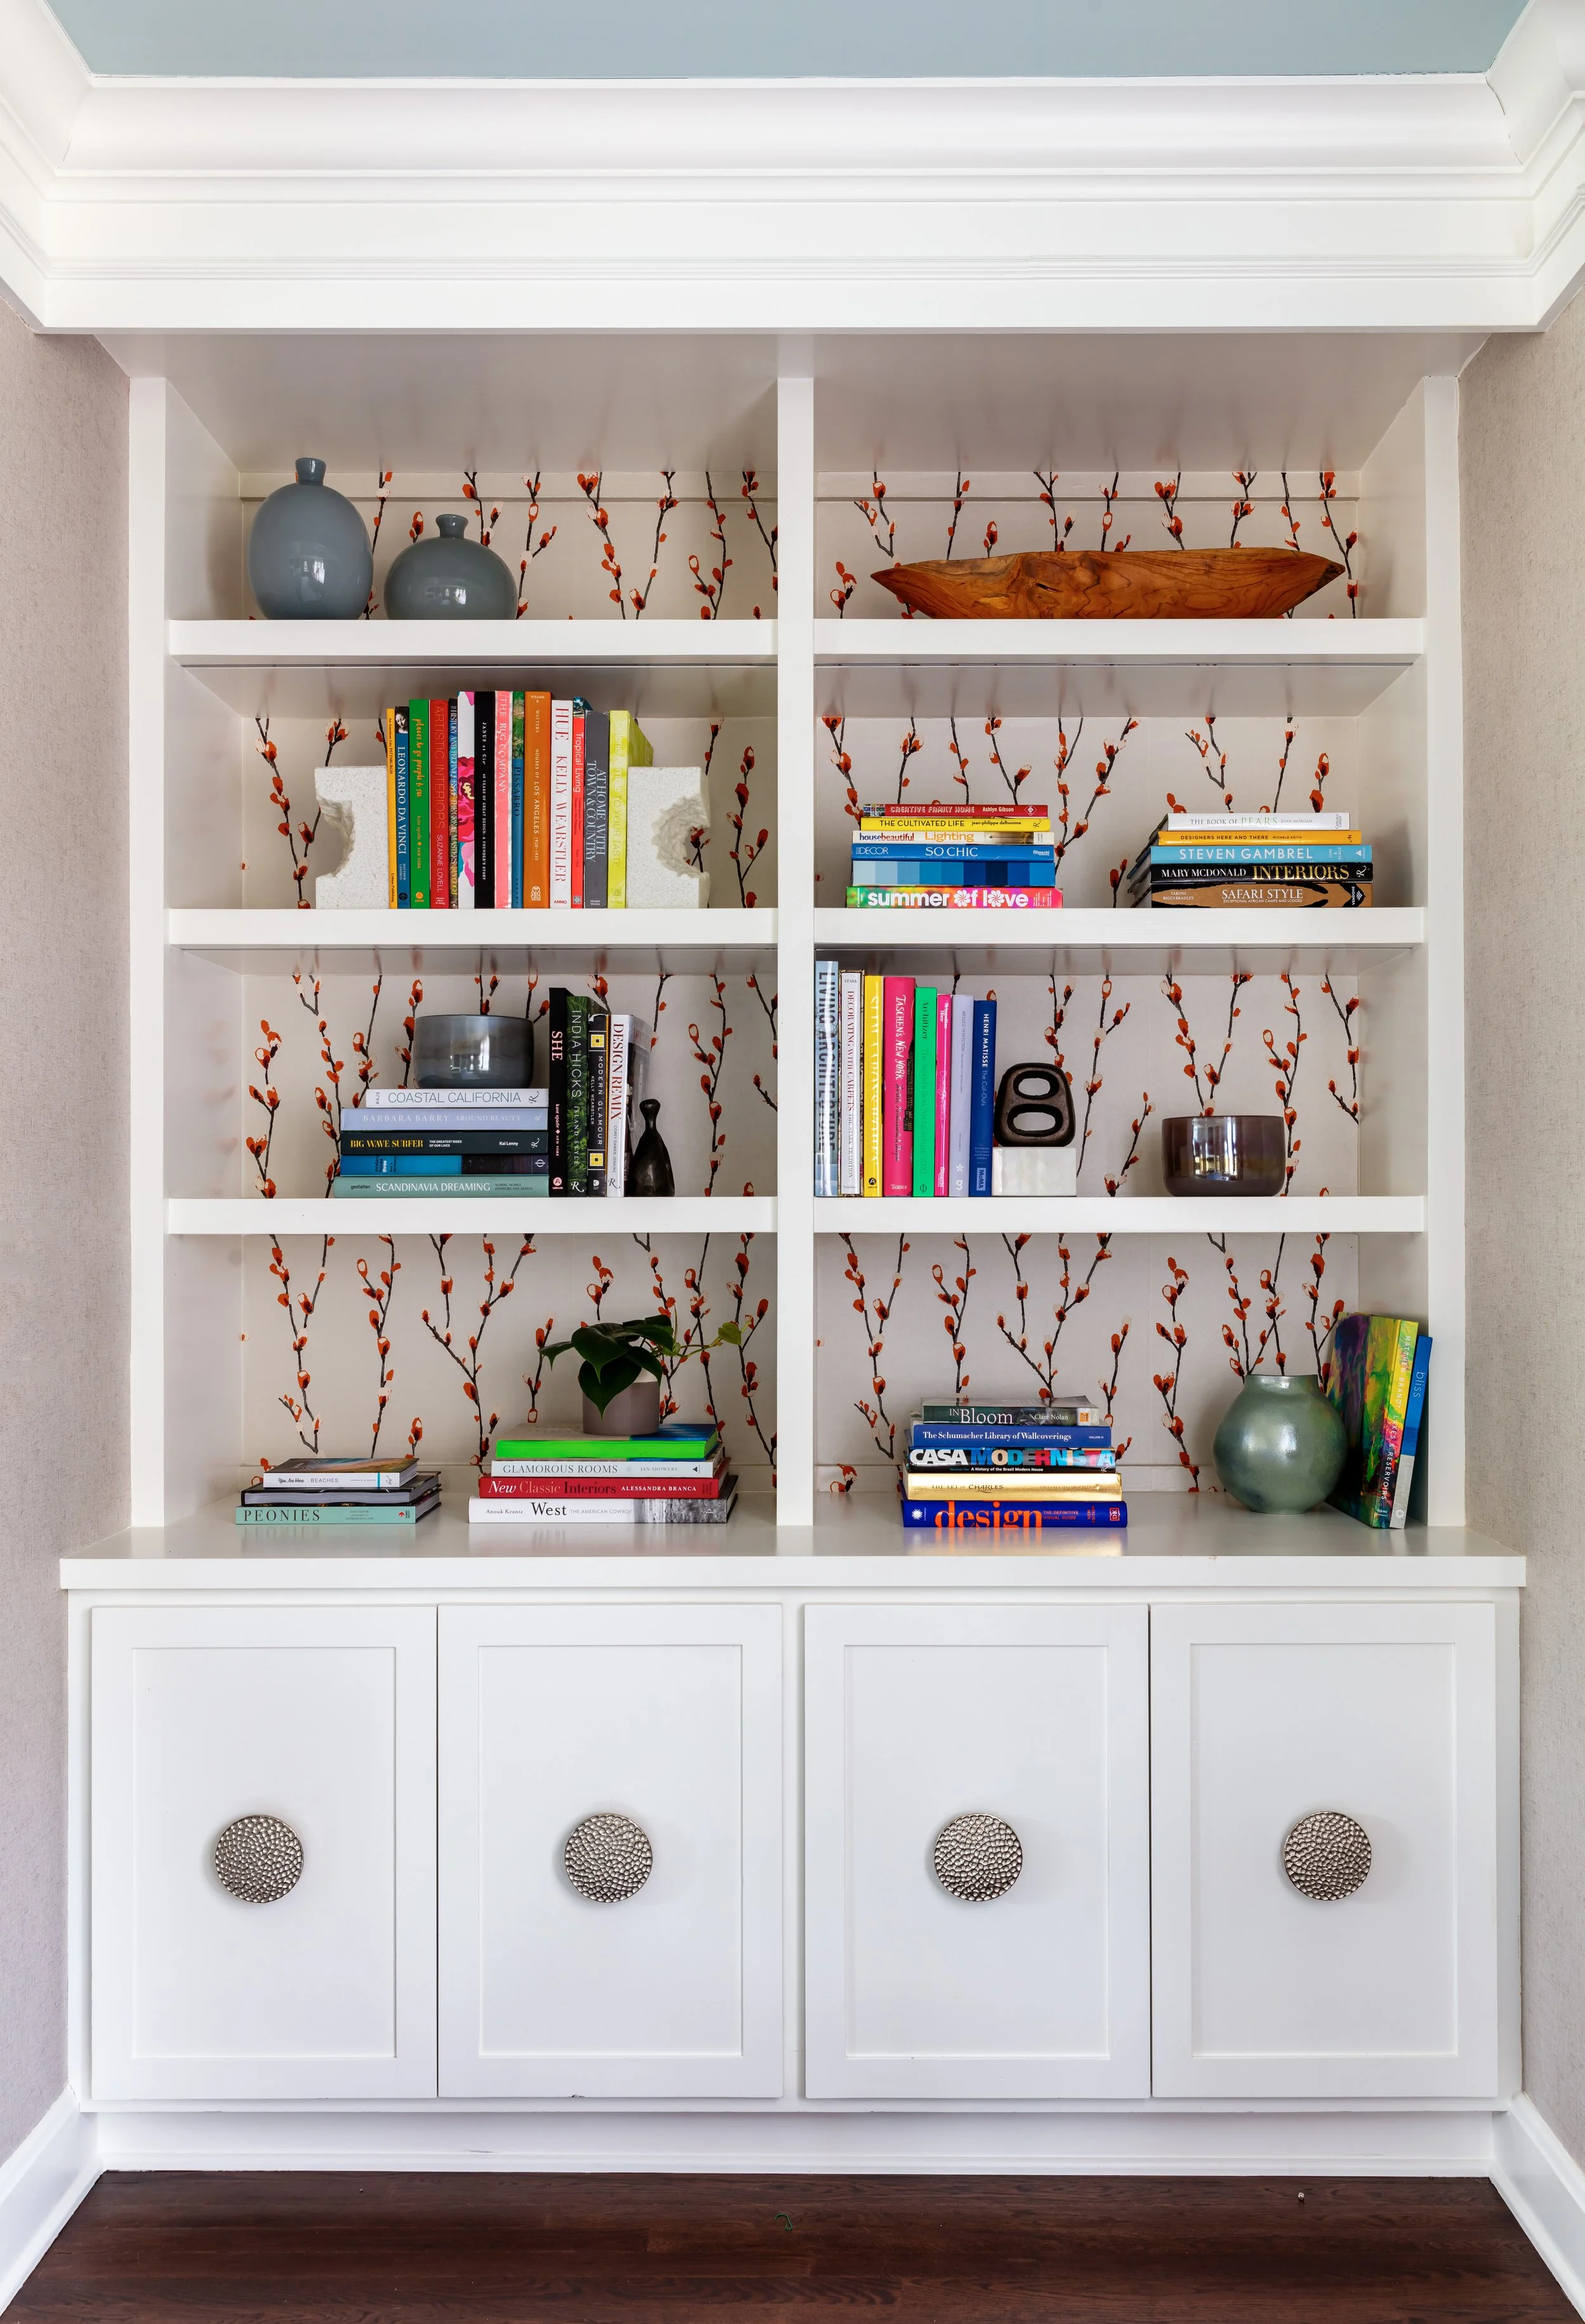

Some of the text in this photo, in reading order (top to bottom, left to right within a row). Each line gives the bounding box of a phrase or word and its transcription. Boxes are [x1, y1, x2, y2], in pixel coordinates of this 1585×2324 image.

[555, 707, 569, 740] HUE
[434, 705, 445, 828] ARTISTIC INTERIORS
[573, 732, 584, 793] Tropical Living
[398, 808, 406, 821] DA
[555, 756, 567, 882] KELLY WEARSTLER
[586, 761, 597, 863] TOWN & COUNTRY
[596, 769, 606, 856] AT HOME WITH
[1241, 817, 1277, 826] PEARS
[613, 794, 622, 867] TO YOUR TASTE
[859, 833, 914, 841] housebeautiful
[925, 832, 974, 842] Lighting
[925, 847, 978, 857] SO CHIC
[1179, 849, 1313, 859] STEVEN GAMBREL
[1161, 869, 1190, 877] MARY
[1252, 865, 1349, 880] INTERIORS
[1222, 889, 1303, 899] SAFARI STYLE
[552, 1031, 563, 1061] SHE
[572, 1010, 581, 1097] INDIA HICKS
[819, 972, 835, 1151] LIVING ARCHITECTURE
[611, 1023, 624, 1120] DESIGN REMIX
[388, 1092, 521, 1103] COASTAL CALIFORNIA
[376, 1183, 490, 1191] SCANDINAVIA DREAMING
[1395, 1336, 1411, 1408] MATTHEW BRANDT
[1413, 1372, 1427, 1398] bliss
[960, 1408, 1014, 1424] Bloom
[985, 1432, 1011, 1441] Library
[1020, 1432, 1071, 1441] Wallcoverings
[909, 1449, 1116, 1466] CASA MODERNISTA
[503, 1465, 618, 1473] GLAMOROUS ROOMS
[488, 1481, 616, 1493] New Classic Interiors
[244, 1509, 320, 1522] PEONIES
[530, 1502, 567, 1516] West
[935, 1501, 1042, 1528] design
[1112, 1510, 1118, 1519] DK
